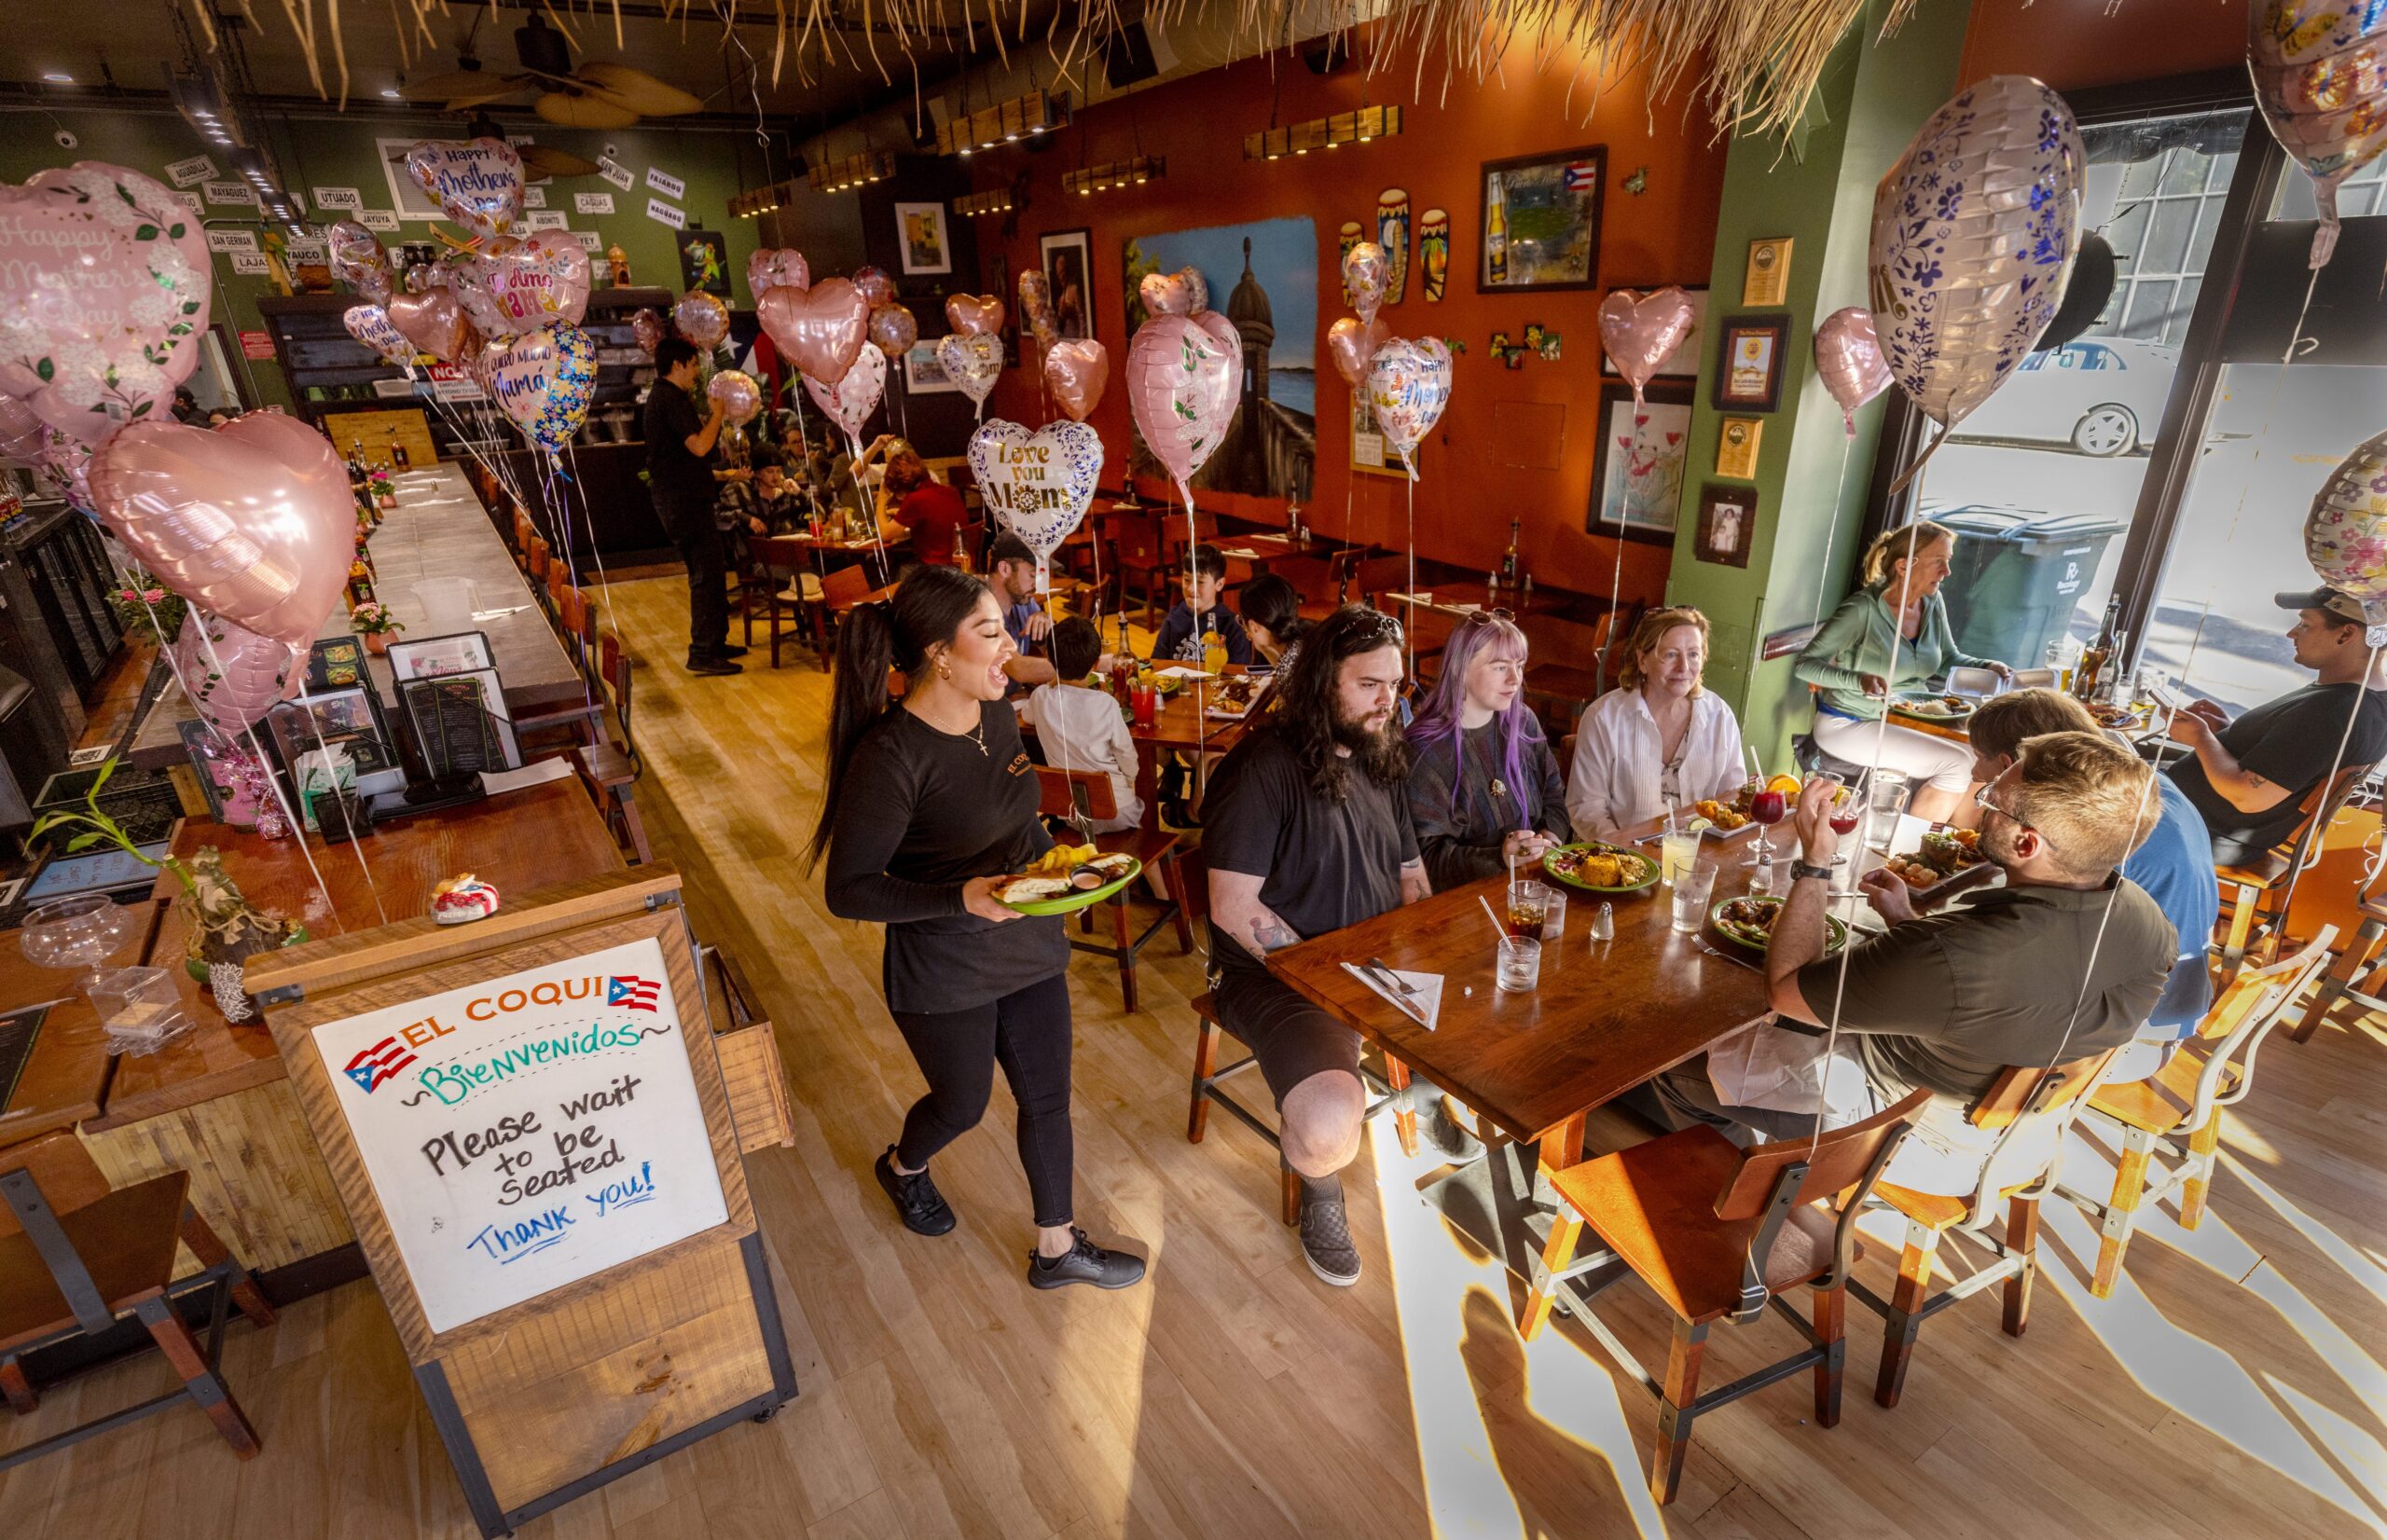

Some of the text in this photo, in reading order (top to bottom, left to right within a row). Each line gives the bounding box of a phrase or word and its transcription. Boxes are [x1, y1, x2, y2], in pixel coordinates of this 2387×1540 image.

[174, 162, 208, 179] AGUADILLA
[438, 161, 517, 196] Mother's
[613, 169, 630, 184] JUAN
[211, 187, 248, 198] MAYAGUEZ
[322, 192, 356, 203] UTUADO
[181, 198, 196, 207] OJO
[580, 198, 608, 207] CAGUAS
[363, 214, 391, 224] JAYUYA
[0, 215, 114, 261] Happy
[212, 235, 252, 246] SAN GERMAN
[286, 251, 320, 260] YAUCO
[509, 267, 553, 289] Amo
[358, 318, 393, 339] Moth
[434, 366, 455, 379] NO
[489, 365, 551, 409] Mamá
[999, 442, 1050, 464] Love
[1012, 466, 1045, 486] you
[398, 975, 603, 1050] EL COQUI
[420, 1074, 642, 1176] Please wait
[494, 1124, 603, 1176] to be
